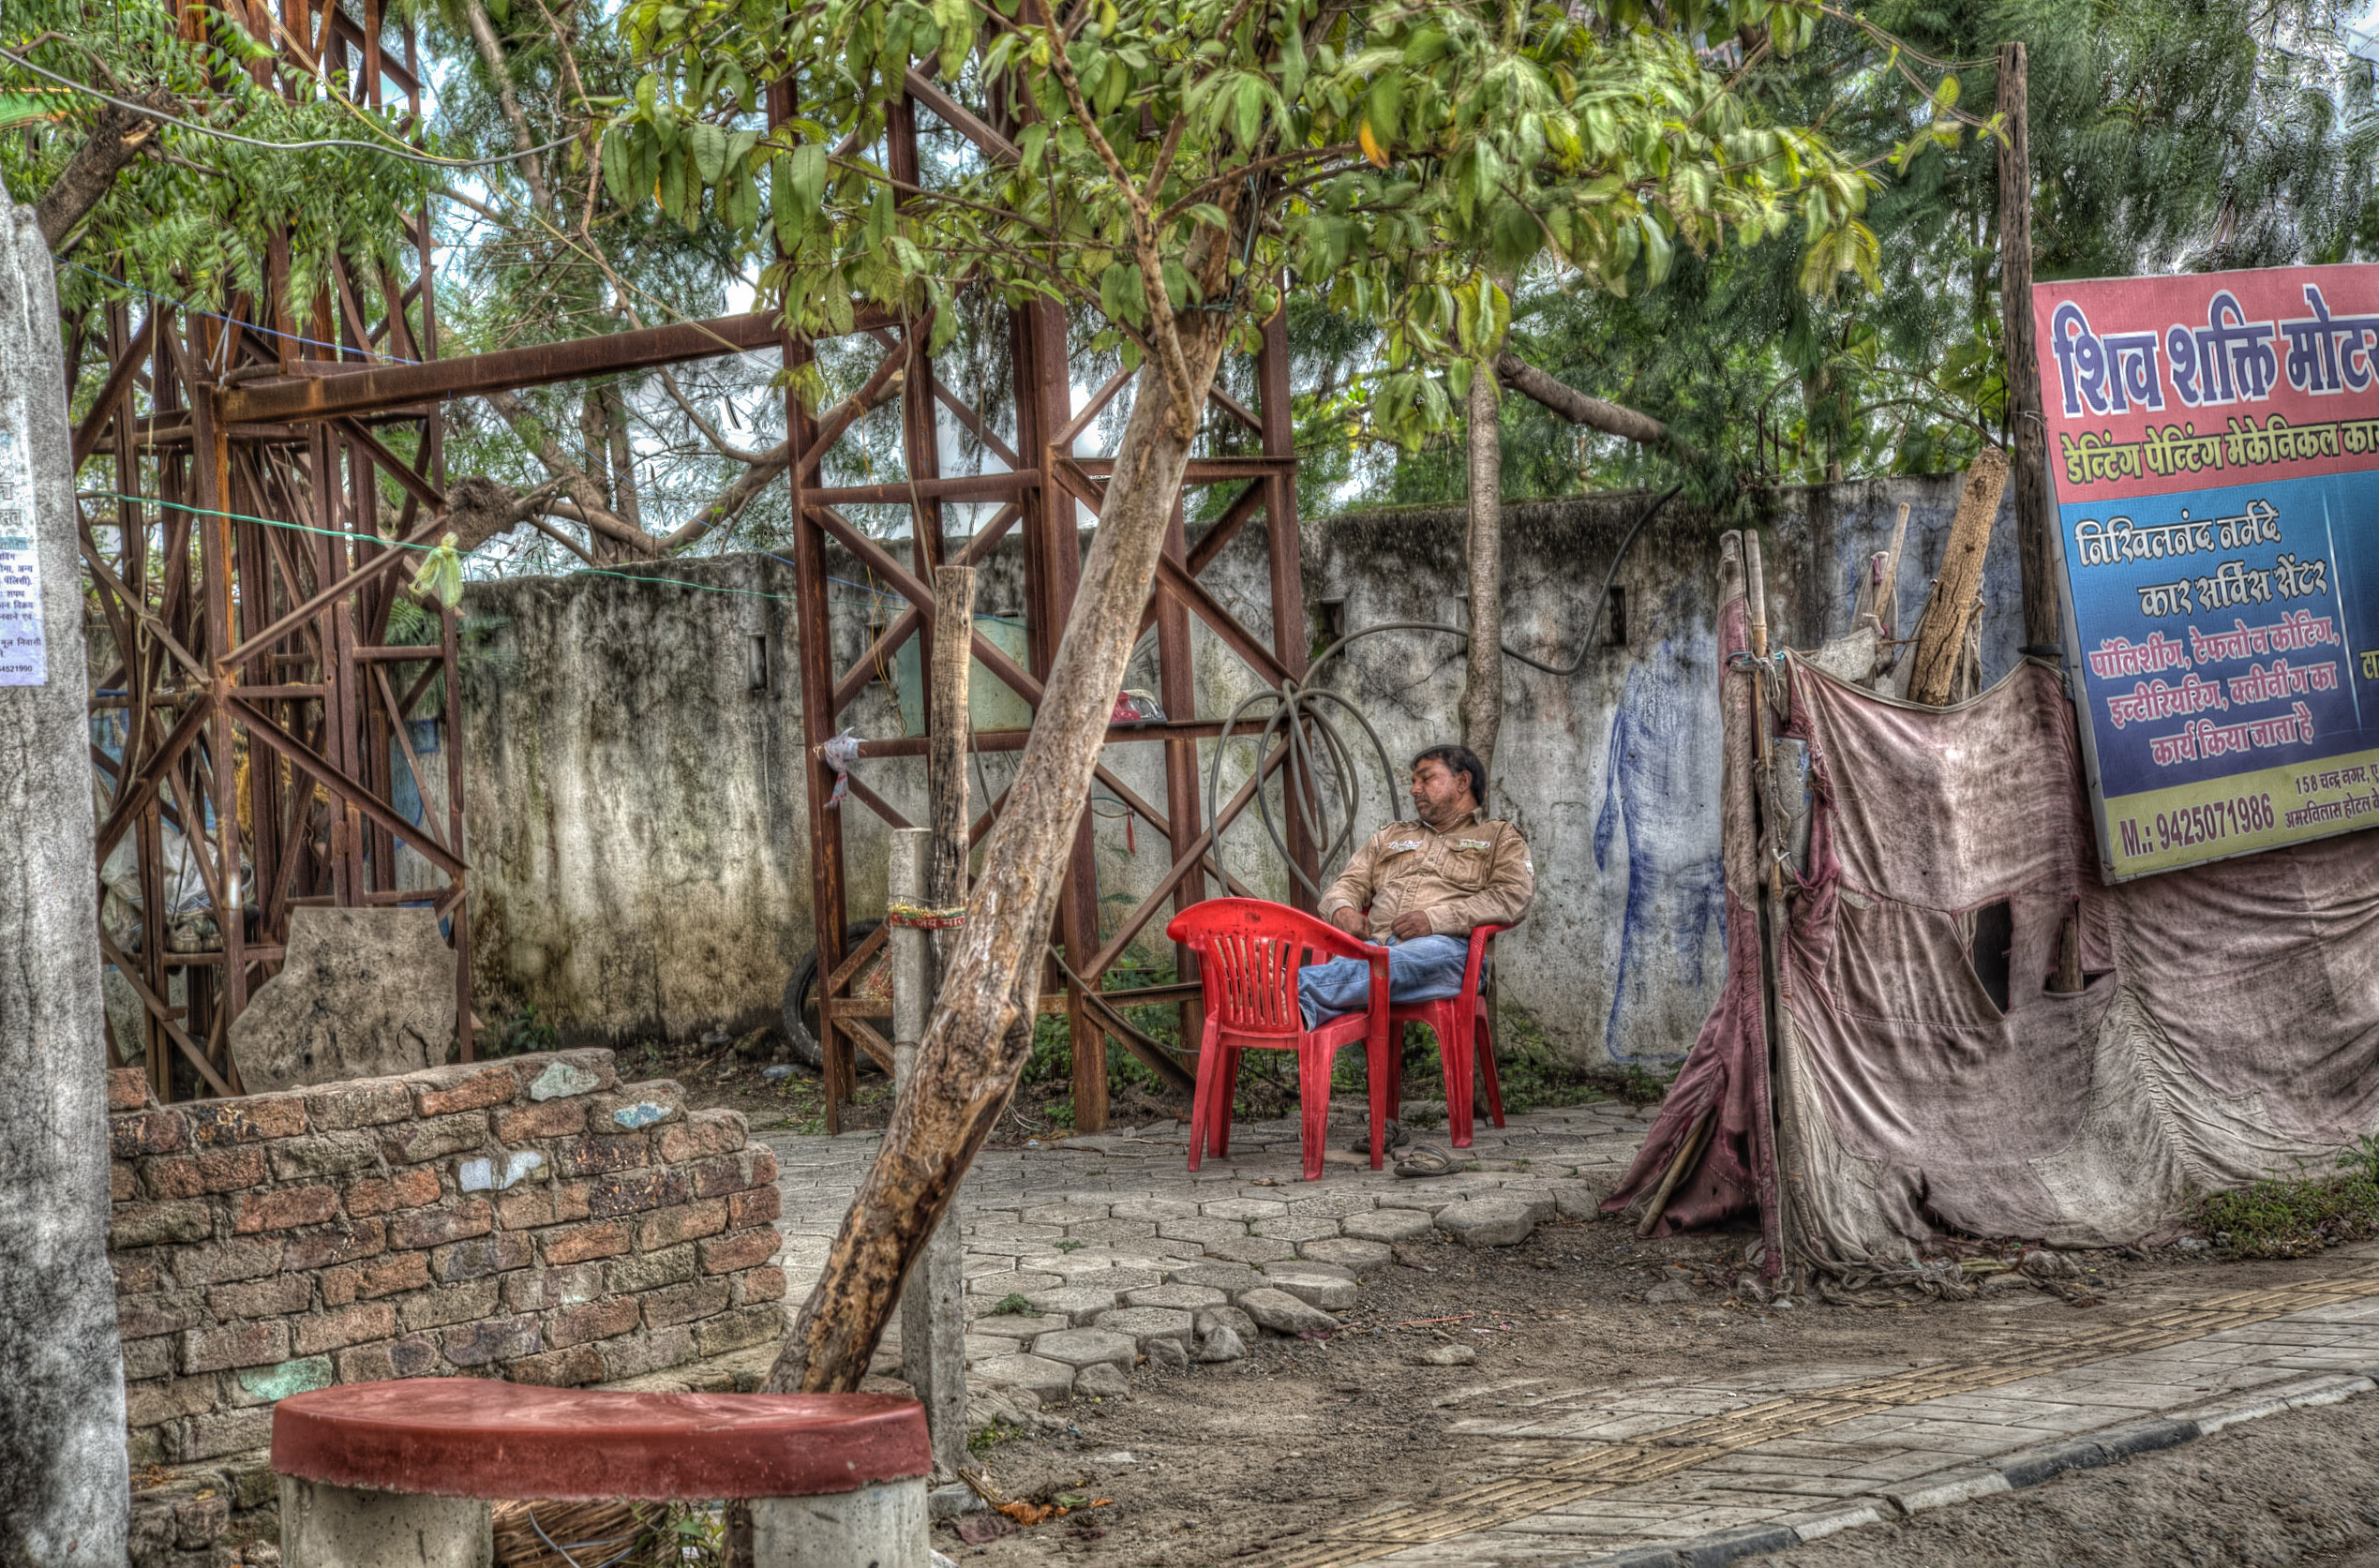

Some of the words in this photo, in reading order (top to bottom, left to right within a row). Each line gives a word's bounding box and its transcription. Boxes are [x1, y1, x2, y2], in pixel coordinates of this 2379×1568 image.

[2052, 301, 2165, 418] शिव
[2166, 290, 2278, 407] शक्ति
[2225, 413, 2341, 468] मेकेनिकल
[2342, 418, 2379, 458] का
[2217, 499, 2282, 549] नर्मदे
[2137, 578, 2192, 618] कार
[2195, 560, 2272, 611] सर्विस
[2274, 553, 2327, 601] सेंटर
[2269, 609, 2340, 652] कोटिंग,
[2309, 662, 2338, 691] का
[2149, 721, 2198, 766] कार्य
[2195, 719, 2251, 759] किया
[2250, 714, 2297, 747] जाता
[2292, 701, 2314, 745] है
[2156, 793, 2275, 851] 9425071986
[2284, 799, 2342, 829] अमरविलास
[2344, 792, 2371, 820] होटल
